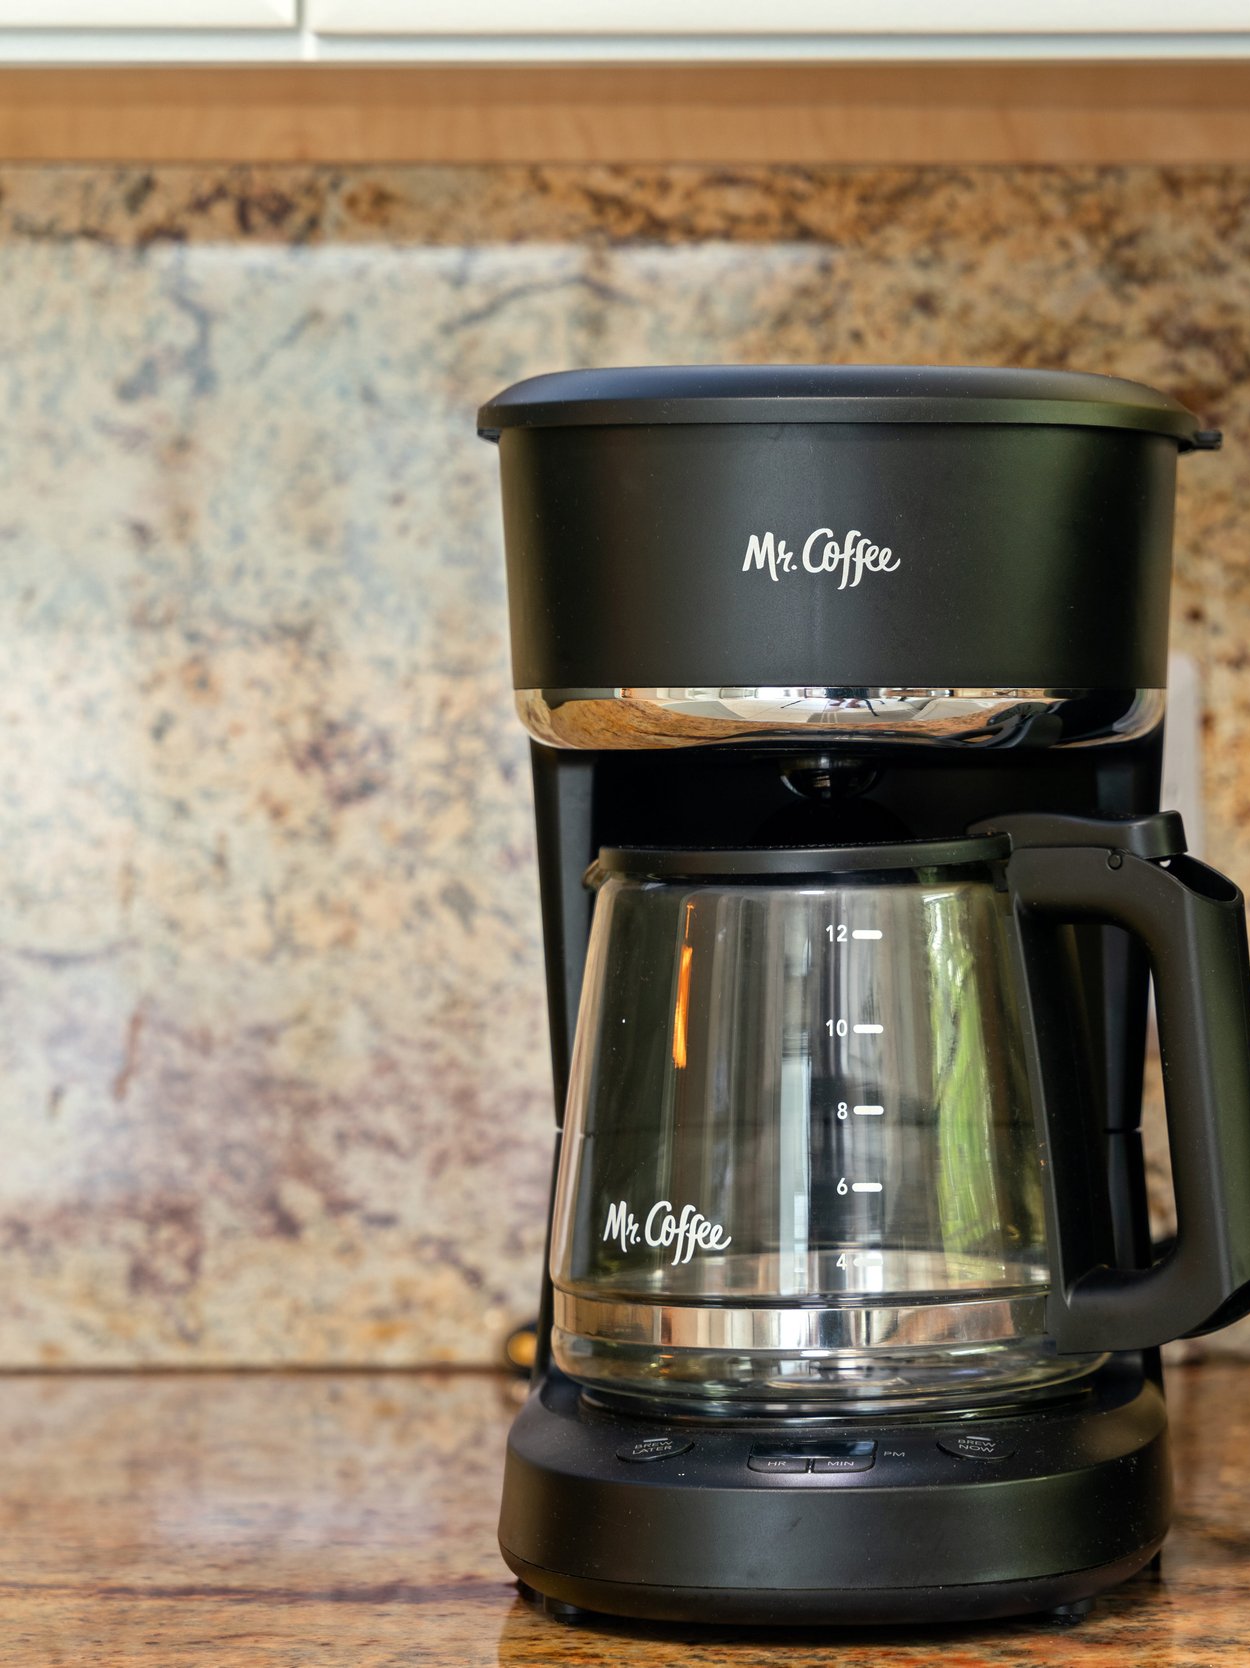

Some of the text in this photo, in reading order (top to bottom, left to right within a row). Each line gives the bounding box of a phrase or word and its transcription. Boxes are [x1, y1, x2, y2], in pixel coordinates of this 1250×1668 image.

[742, 528, 901, 590] Mr. Coffee
[825, 924, 848, 942] 12
[825, 1019, 848, 1037] 10
[837, 1101, 848, 1120] 8
[836, 1177, 848, 1195] 6
[603, 1200, 732, 1266] Mr. Coffee
[836, 1253, 848, 1271] 4
[632, 1445, 673, 1455] LATER
[634, 1441, 673, 1450] BREW
[957, 1439, 996, 1448] BREW
[958, 1444, 994, 1453] NOW
[883, 1450, 906, 1458] PM
